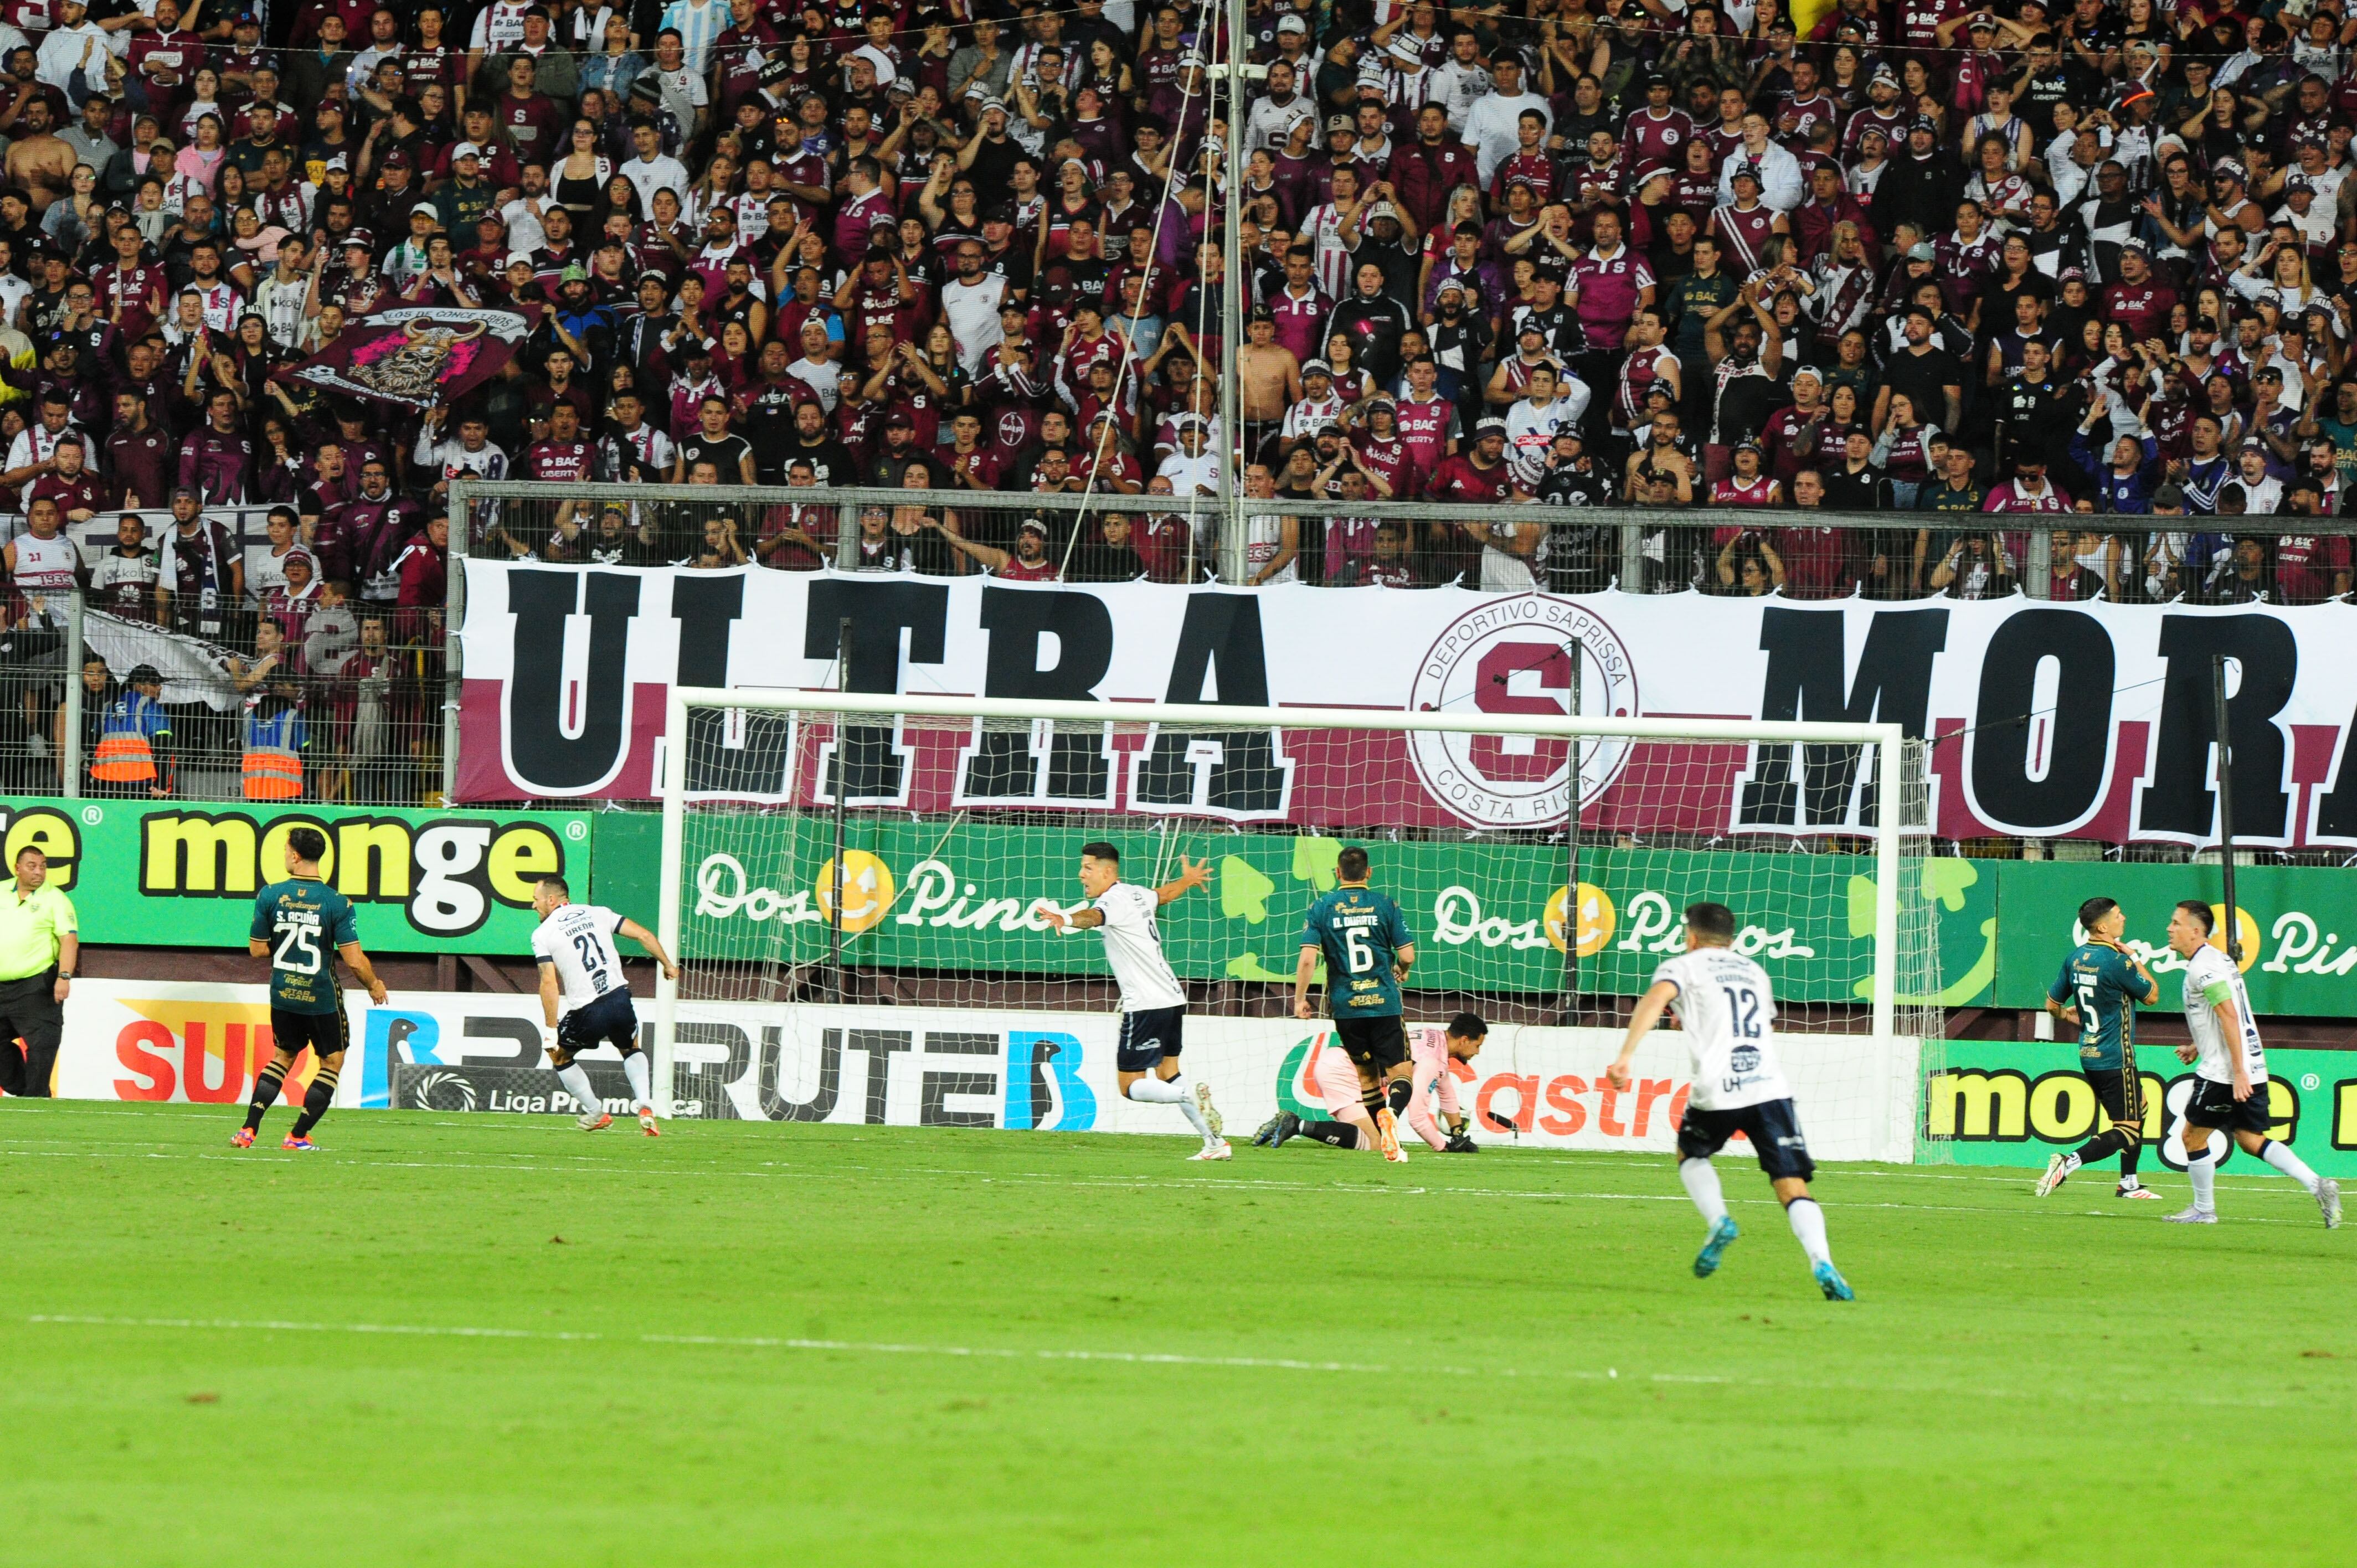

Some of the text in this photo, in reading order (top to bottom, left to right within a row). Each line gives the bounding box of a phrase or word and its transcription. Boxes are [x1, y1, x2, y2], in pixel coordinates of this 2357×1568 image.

[1919, 13, 1939, 23] BAC
[420, 58, 440, 68] BAC
[2045, 81, 2066, 91] BAC
[514, 110, 526, 123] S
[1333, 114, 1342, 125] S
[1444, 152, 1454, 162] S
[1609, 170, 1618, 178] S
[1972, 247, 1984, 257] S
[1613, 261, 1625, 274] S
[136, 270, 145, 280] S
[2144, 291, 2153, 300] S
[1305, 303, 1318, 316] S
[90, 333, 101, 347] S
[1097, 344, 1109, 355] S
[913, 395, 925, 409] S
[1430, 406, 1440, 417] S
[1413, 420, 1438, 431] BAC
[241, 441, 251, 453] S
[573, 445, 584, 455] S
[1392, 444, 1402, 455] S
[555, 456, 580, 467] BAC
[970, 456, 980, 466] S
[541, 470, 579, 478] LIBERTY
[1861, 473, 1870, 483] S
[1496, 485, 1505, 496] S
[2049, 498, 2058, 509] S
[388, 509, 400, 524] S
[1426, 601, 1538, 680] DEPORTIVO
[1546, 605, 1627, 687] SAPRISSA
[505, 570, 2357, 839] ULTRA MOR
[1468, 641, 1573, 782] S
[1437, 769, 1515, 818] COSTA
[145, 813, 558, 931] monge
[696, 853, 822, 924] Dos
[276, 909, 320, 926] S. ACUÑA
[1344, 915, 1378, 927] DUARTE
[1432, 885, 1815, 959] Dos Pios
[273, 922, 322, 975] 25
[573, 932, 607, 972] 21
[1346, 927, 1374, 973] 6
[284, 973, 314, 987] Tropical
[285, 988, 311, 996] STAR
[287, 994, 316, 1003] CARS
[1723, 987, 1761, 1038] 12
[2078, 985, 2100, 1034] 5
[490, 1089, 545, 1115] Liga
